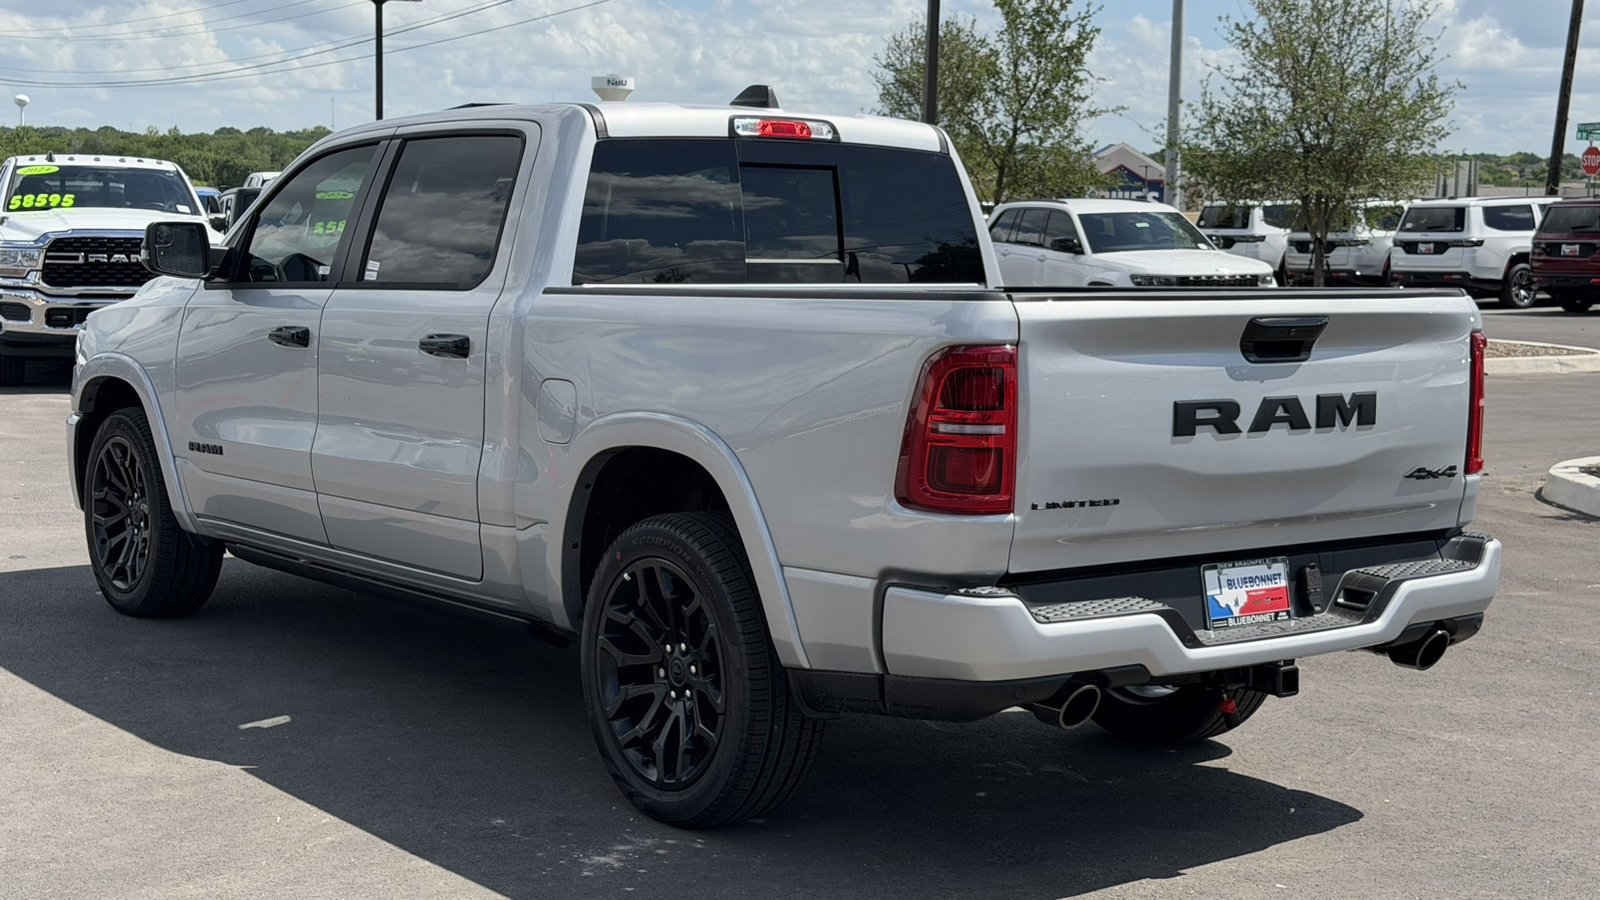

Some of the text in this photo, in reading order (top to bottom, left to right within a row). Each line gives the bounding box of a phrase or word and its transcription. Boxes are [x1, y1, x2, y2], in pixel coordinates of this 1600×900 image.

[1582, 155, 1600, 167] STOP
[9, 193, 76, 210] 58595
[1172, 391, 1377, 437] RAM
[188, 441, 223, 456] RAM
[1031, 499, 1120, 510] LIMITED
[631, 535, 693, 562] SCORPION
[1226, 573, 1282, 590] BLUEBONNET
[1227, 613, 1275, 627] BLUEBONNET
